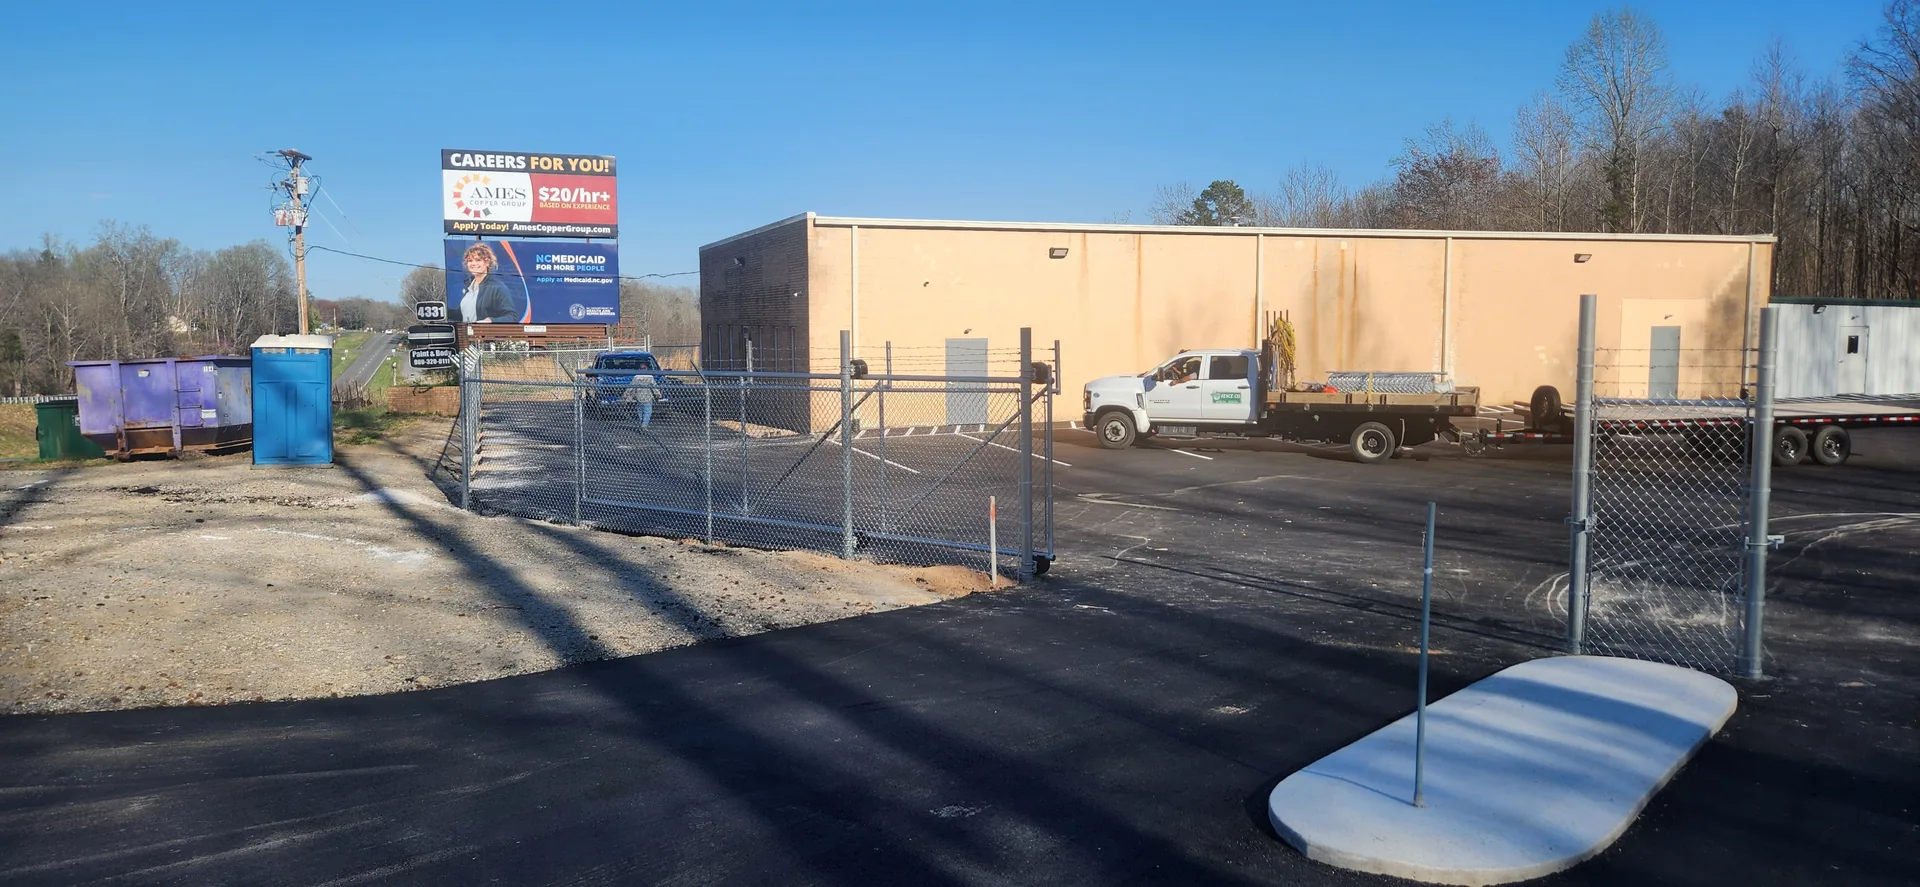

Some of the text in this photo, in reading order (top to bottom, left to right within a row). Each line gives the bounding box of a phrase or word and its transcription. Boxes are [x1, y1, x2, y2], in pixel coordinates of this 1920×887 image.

[450, 153, 609, 173] CAREERS FOR YOU!
[470, 187, 526, 200] AMES
[538, 186, 610, 203] $20/hr+
[453, 222, 611, 235] Apply Today! AmesCopperGroup.com
[536, 254, 606, 264] NCMEDICAID
[418, 306, 444, 318] 4331
